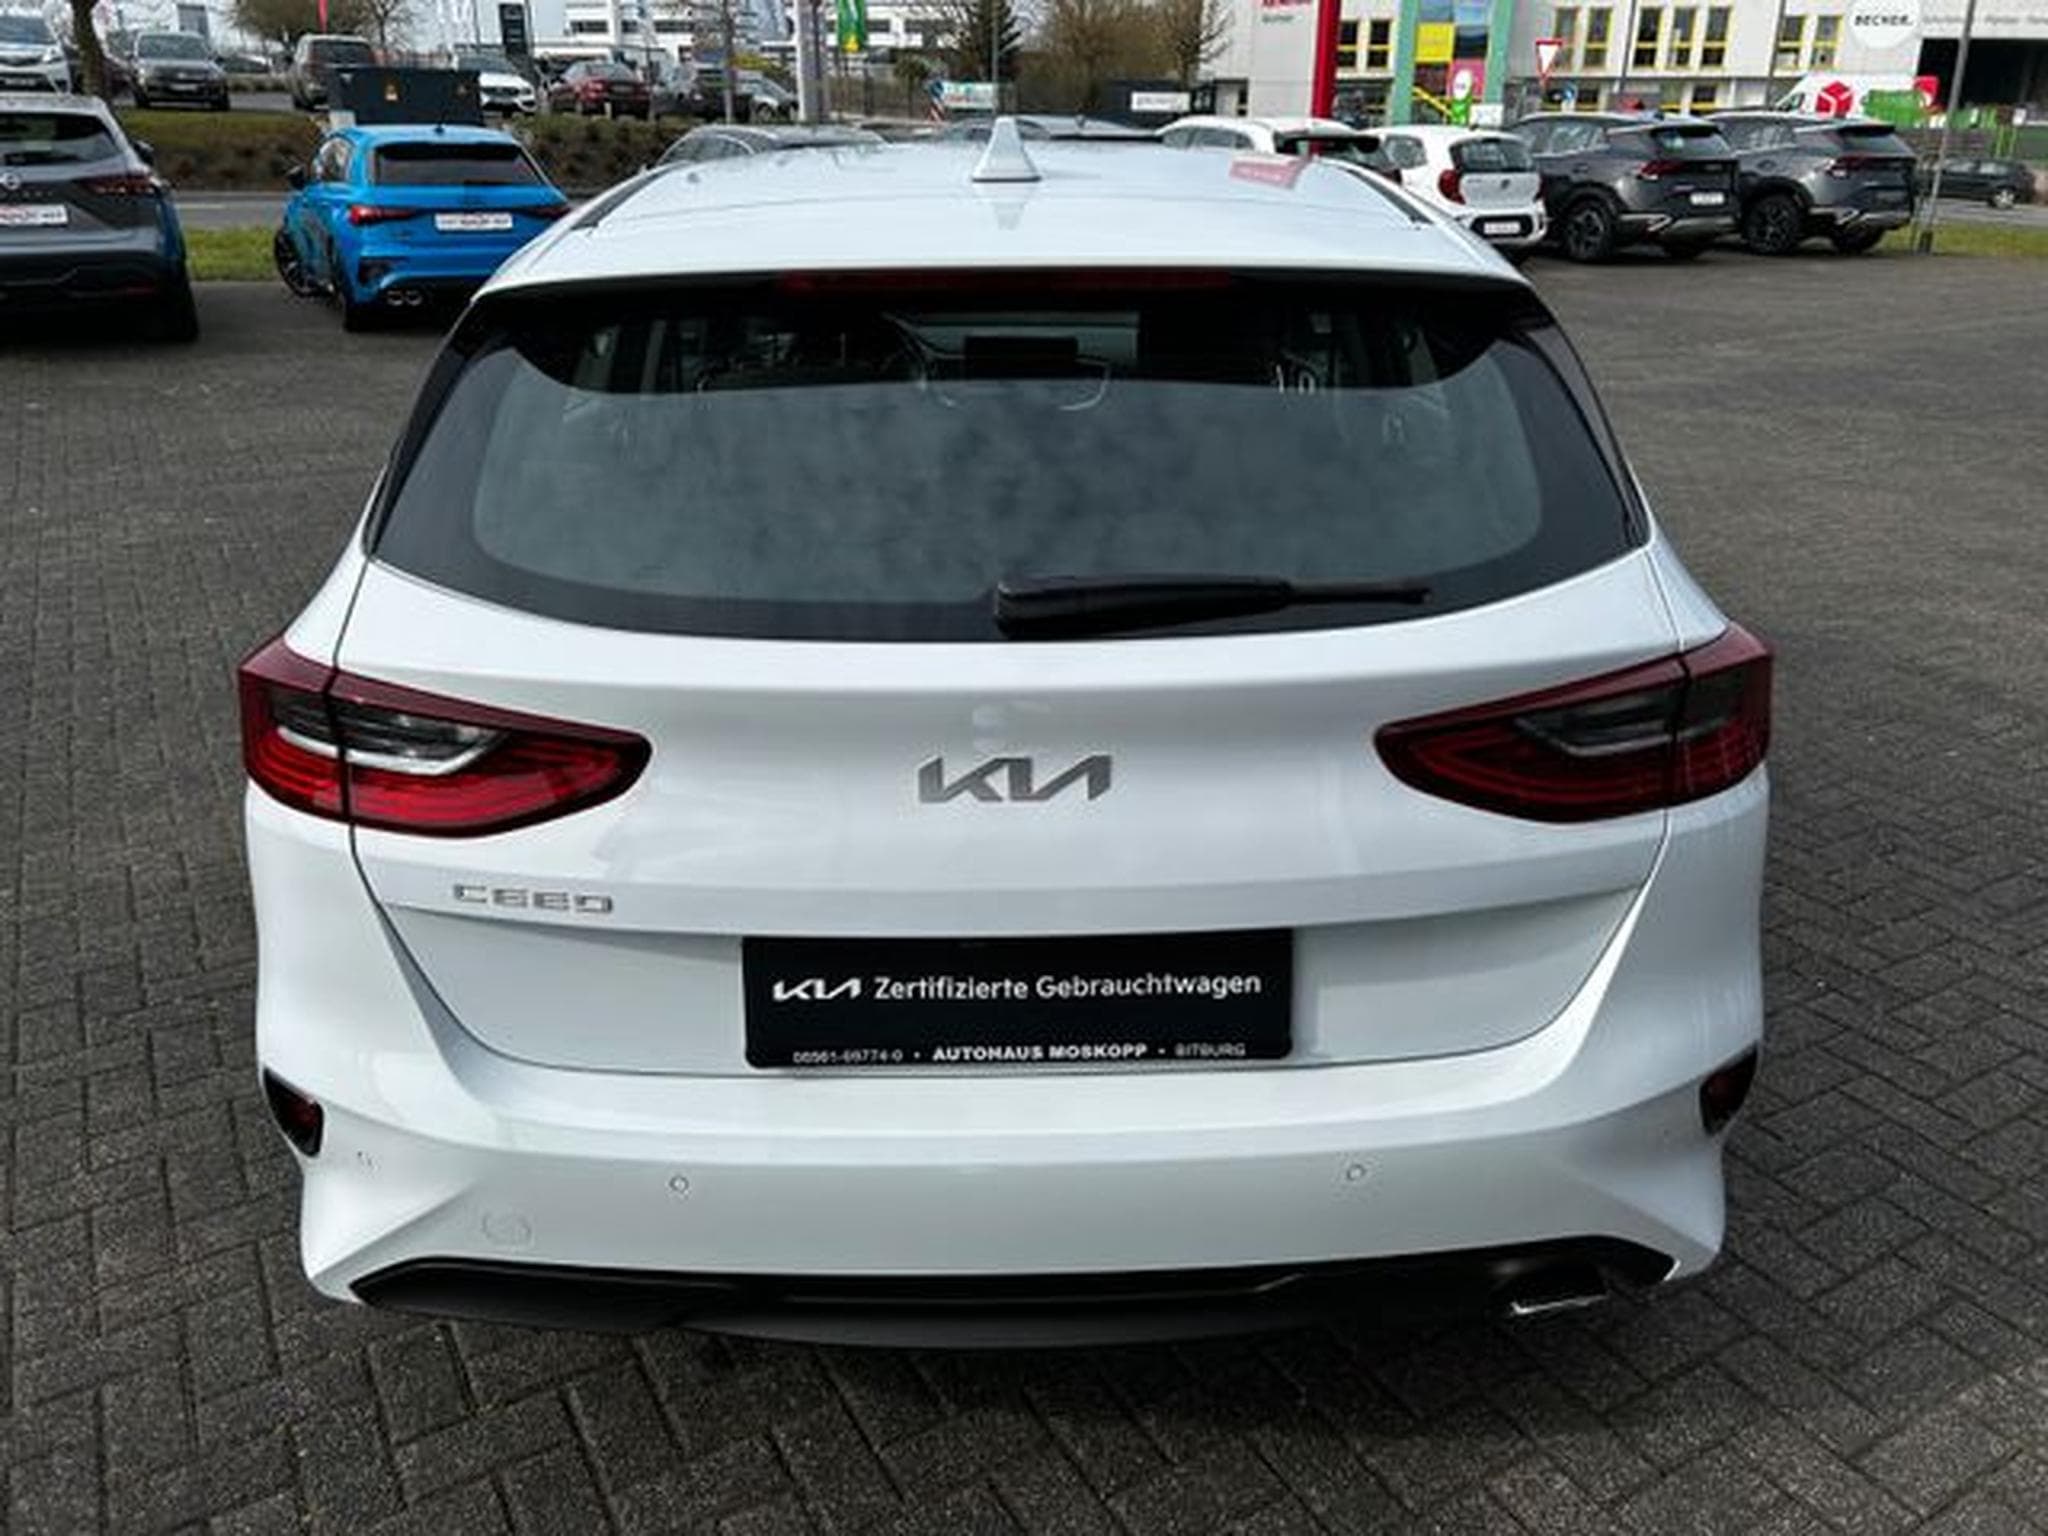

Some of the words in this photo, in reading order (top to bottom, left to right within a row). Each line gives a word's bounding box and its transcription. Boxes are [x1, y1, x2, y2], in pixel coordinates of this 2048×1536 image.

[918, 755, 1112, 803] KIA
[773, 977, 862, 1001] KIA
[874, 976, 1029, 1000] Zertifizierte
[1036, 972, 1262, 1000] Gebrauchtwagen
[932, 1046, 1044, 1061] AUTOHAUS
[1049, 1042, 1148, 1060] MOSKOPP
